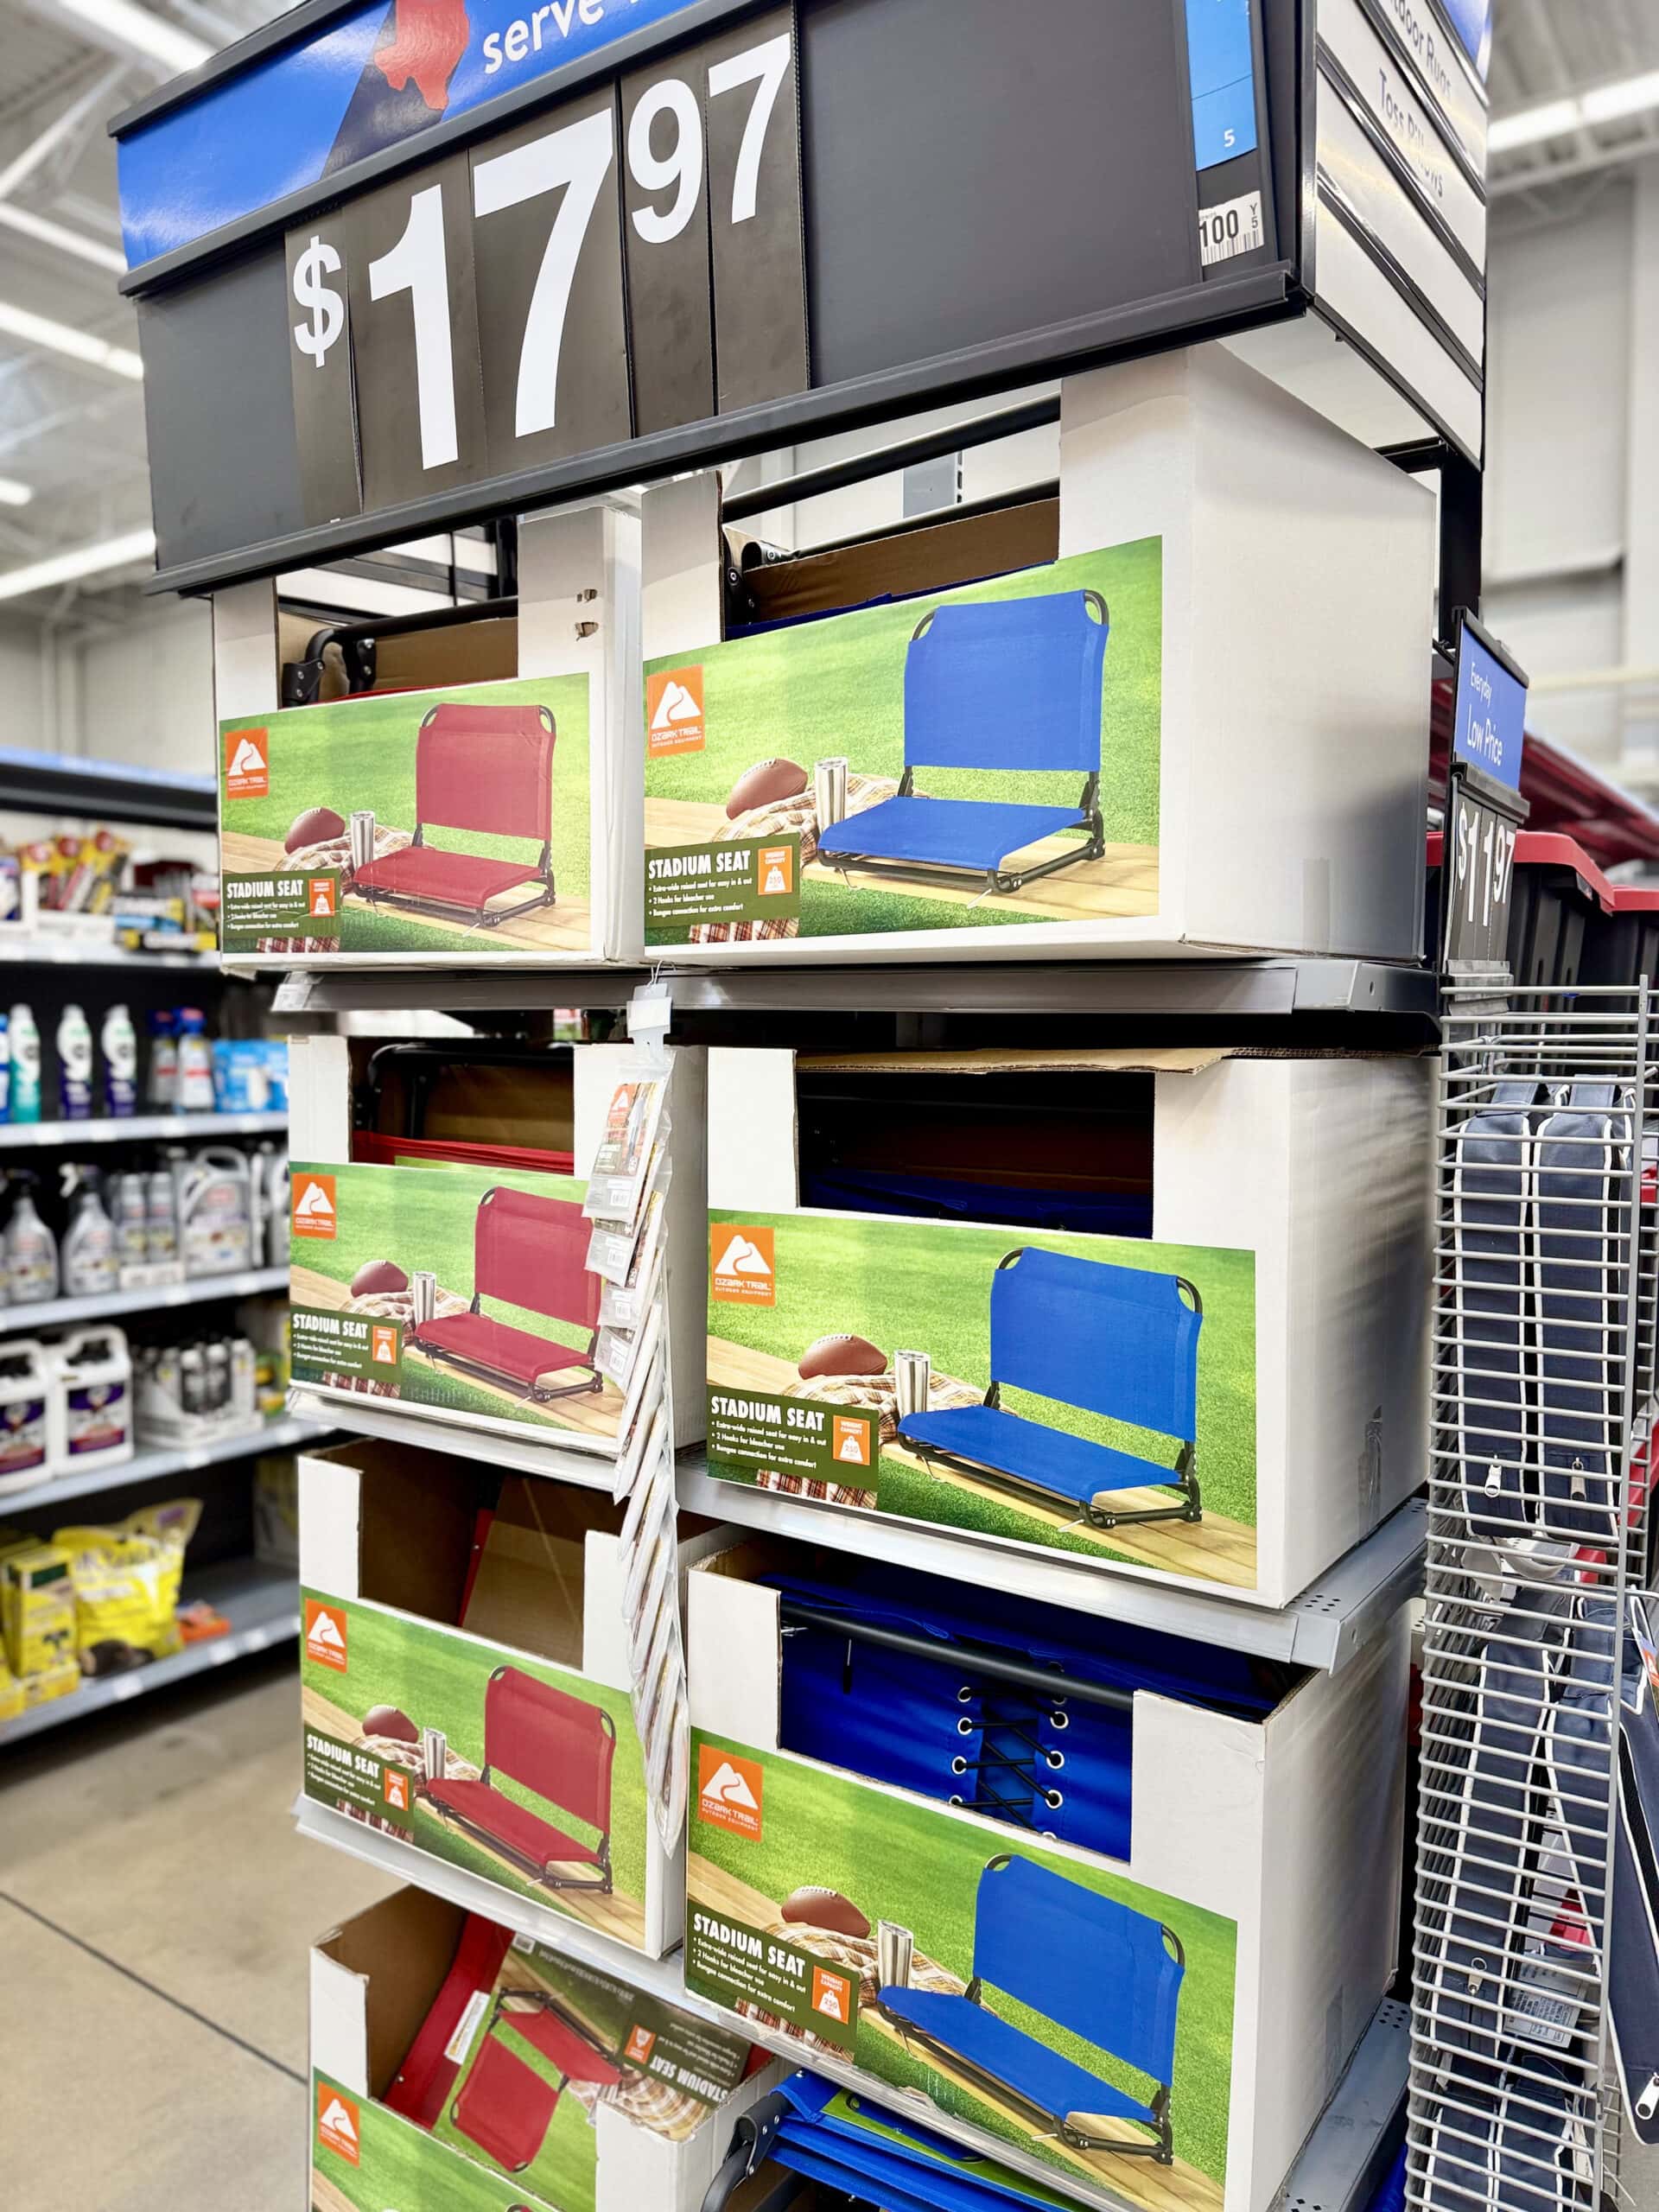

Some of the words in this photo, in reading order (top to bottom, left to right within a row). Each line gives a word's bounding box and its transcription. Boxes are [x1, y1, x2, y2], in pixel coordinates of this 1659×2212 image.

[1224, 129, 1236, 147] 5
[1249, 202, 1257, 215] Y
[1251, 216, 1258, 228] 5
[1199, 210, 1238, 247] 100
[1471, 662, 1492, 709] Everyday
[1467, 703, 1484, 753] Low
[1484, 717, 1502, 766] Price
[649, 855, 710, 879] STADIUM
[716, 850, 750, 873] SEAT
[226, 881, 275, 899] STADIUM
[277, 880, 304, 896] SEAT
[293, 1313, 340, 1334] STADIUM
[342, 1320, 368, 1338] SEAT
[711, 1396, 781, 1424] STADIUM
[787, 1408, 824, 1431] SEAT
[307, 1734, 353, 1767] STADIUM
[355, 1755, 379, 1778] SEAT
[694, 1913, 763, 1960] STADIUM
[767, 1946, 805, 1978] SEAT
[650, 2055, 677, 2079] SEAT
[677, 2068, 728, 2101] STADIUM
